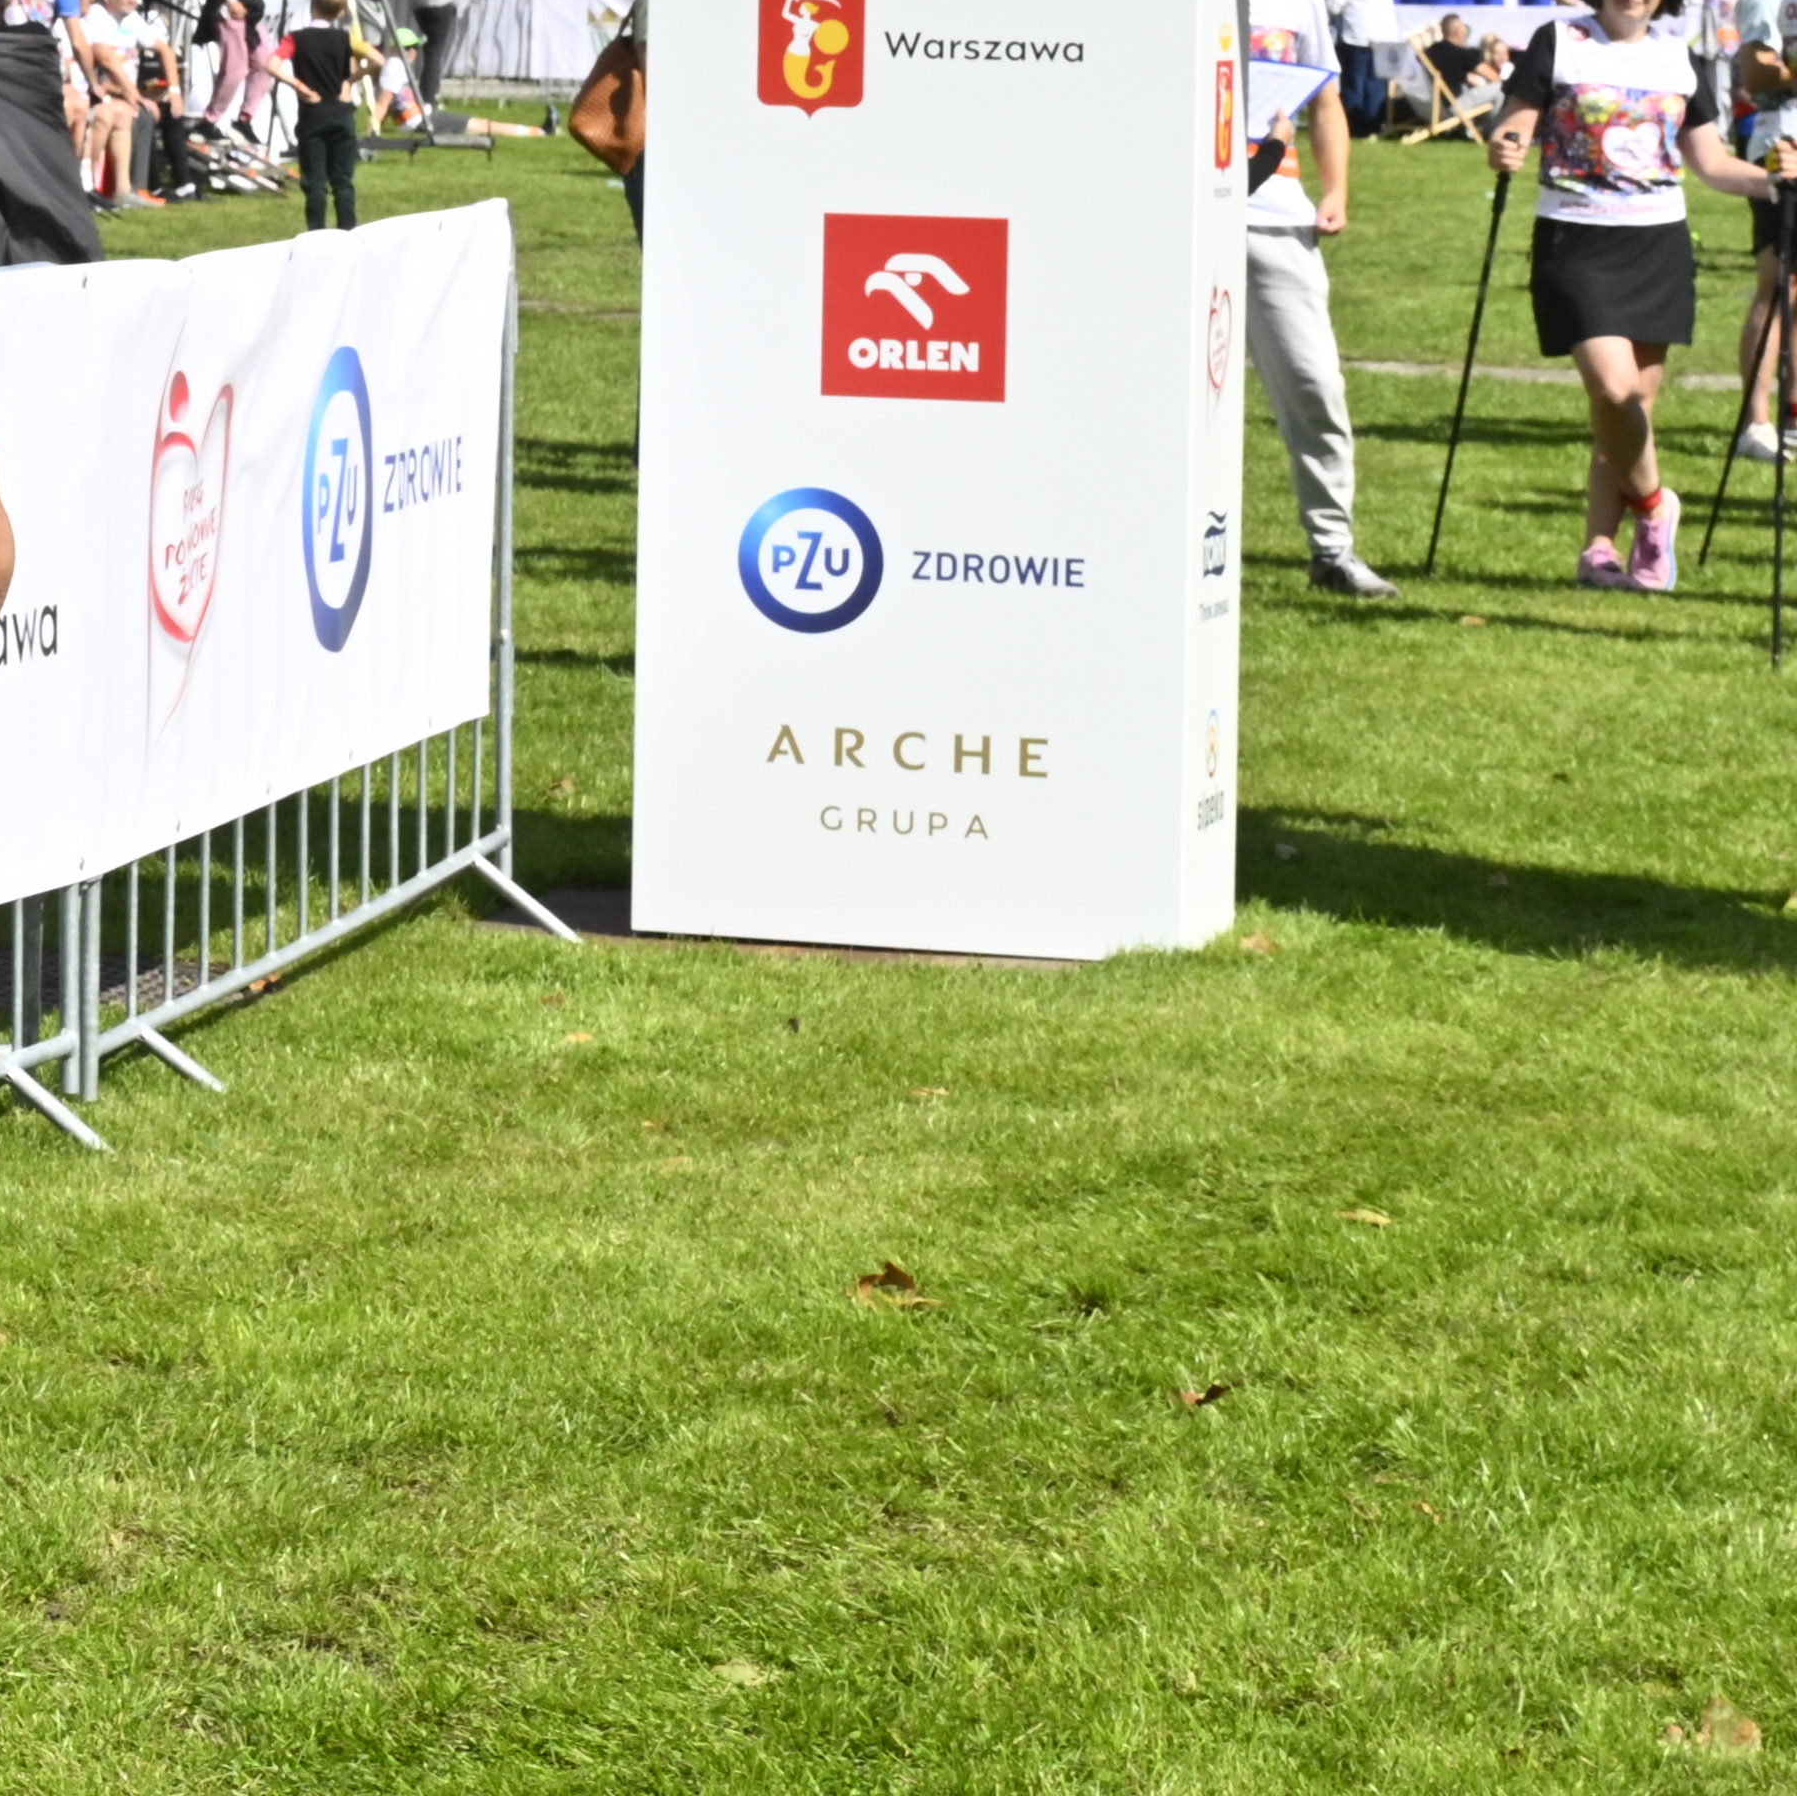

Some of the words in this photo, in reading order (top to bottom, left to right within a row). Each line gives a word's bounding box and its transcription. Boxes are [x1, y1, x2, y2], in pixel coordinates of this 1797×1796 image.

[884, 30, 1086, 64] Warszawa
[847, 337, 980, 373] ORLEN
[384, 436, 462, 513] ZDROWIE
[318, 437, 357, 563] PZU
[771, 530, 851, 591] PZU
[911, 550, 1086, 588] ZDROWIE
[766, 724, 1050, 779] ARCHE
[819, 805, 990, 842] GRUPA
